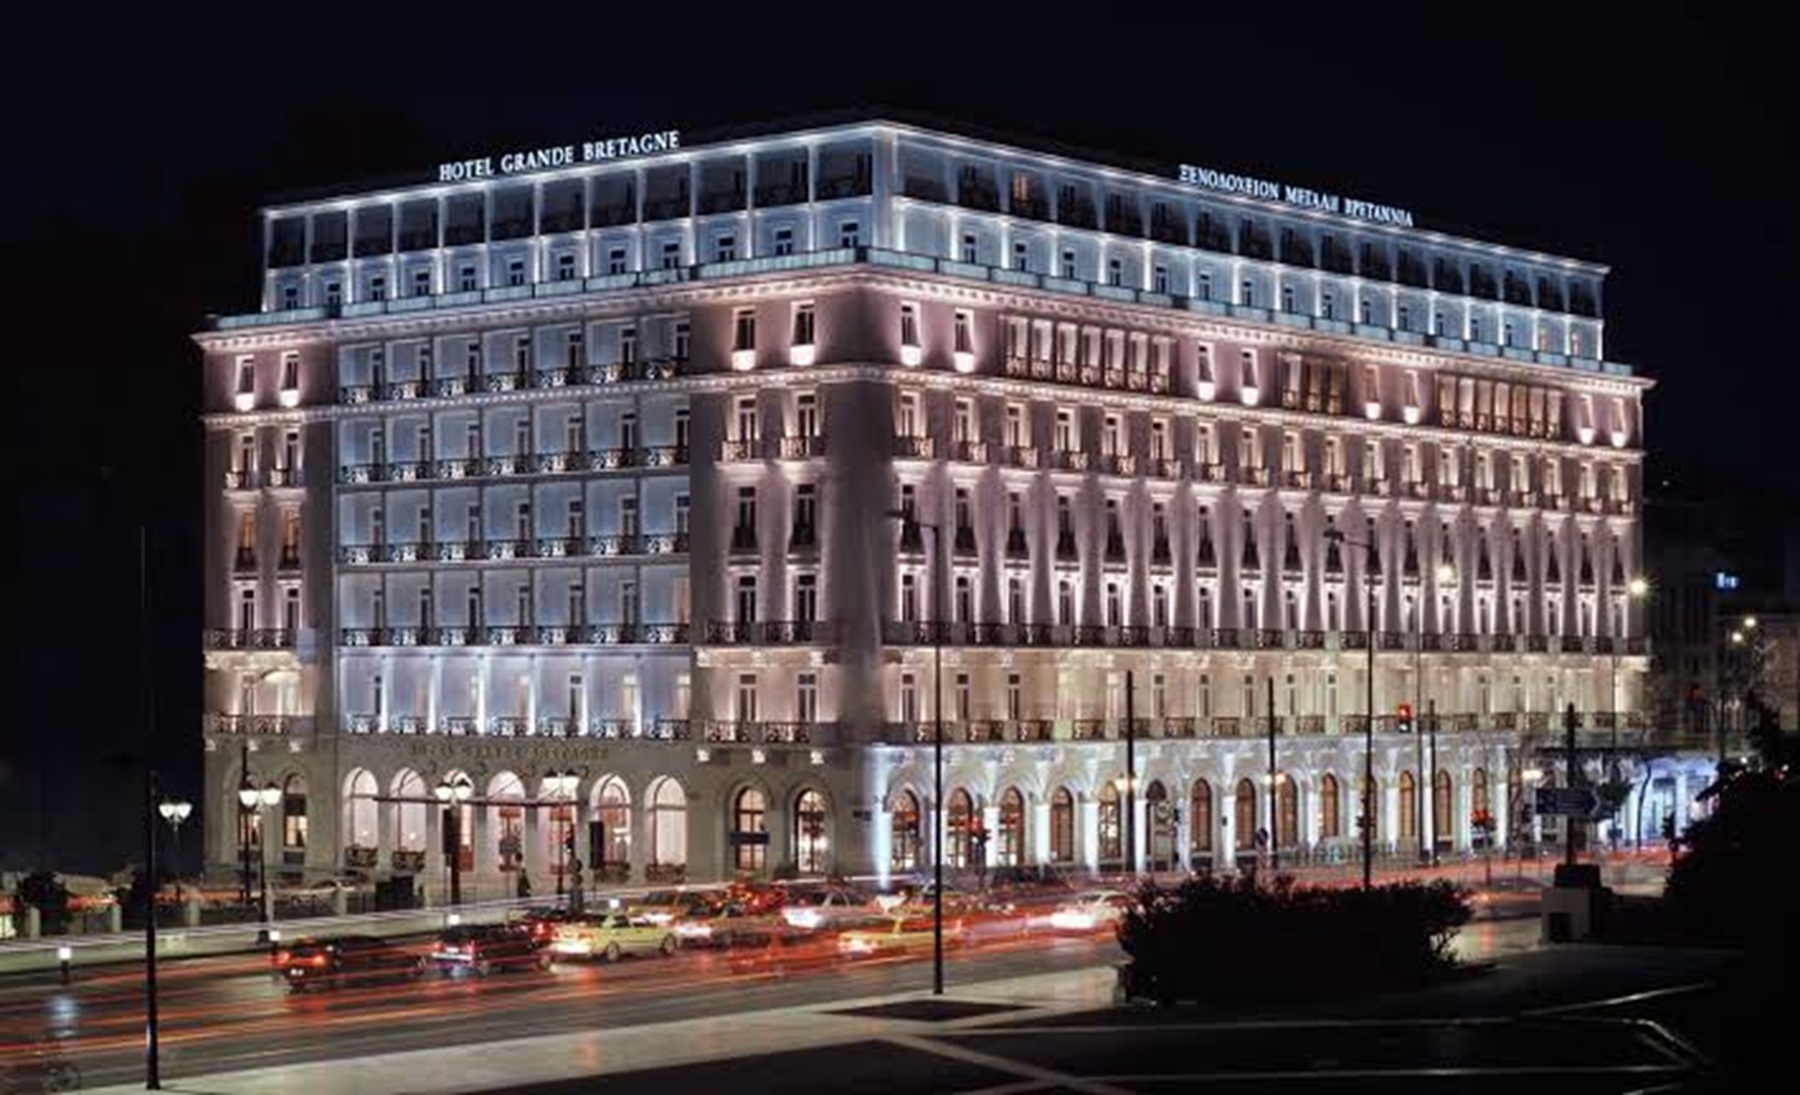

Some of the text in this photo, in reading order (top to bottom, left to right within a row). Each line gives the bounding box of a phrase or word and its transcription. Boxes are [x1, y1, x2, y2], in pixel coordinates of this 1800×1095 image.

[439, 130, 680, 181] HOTEL GRANDE BRETAGNE
